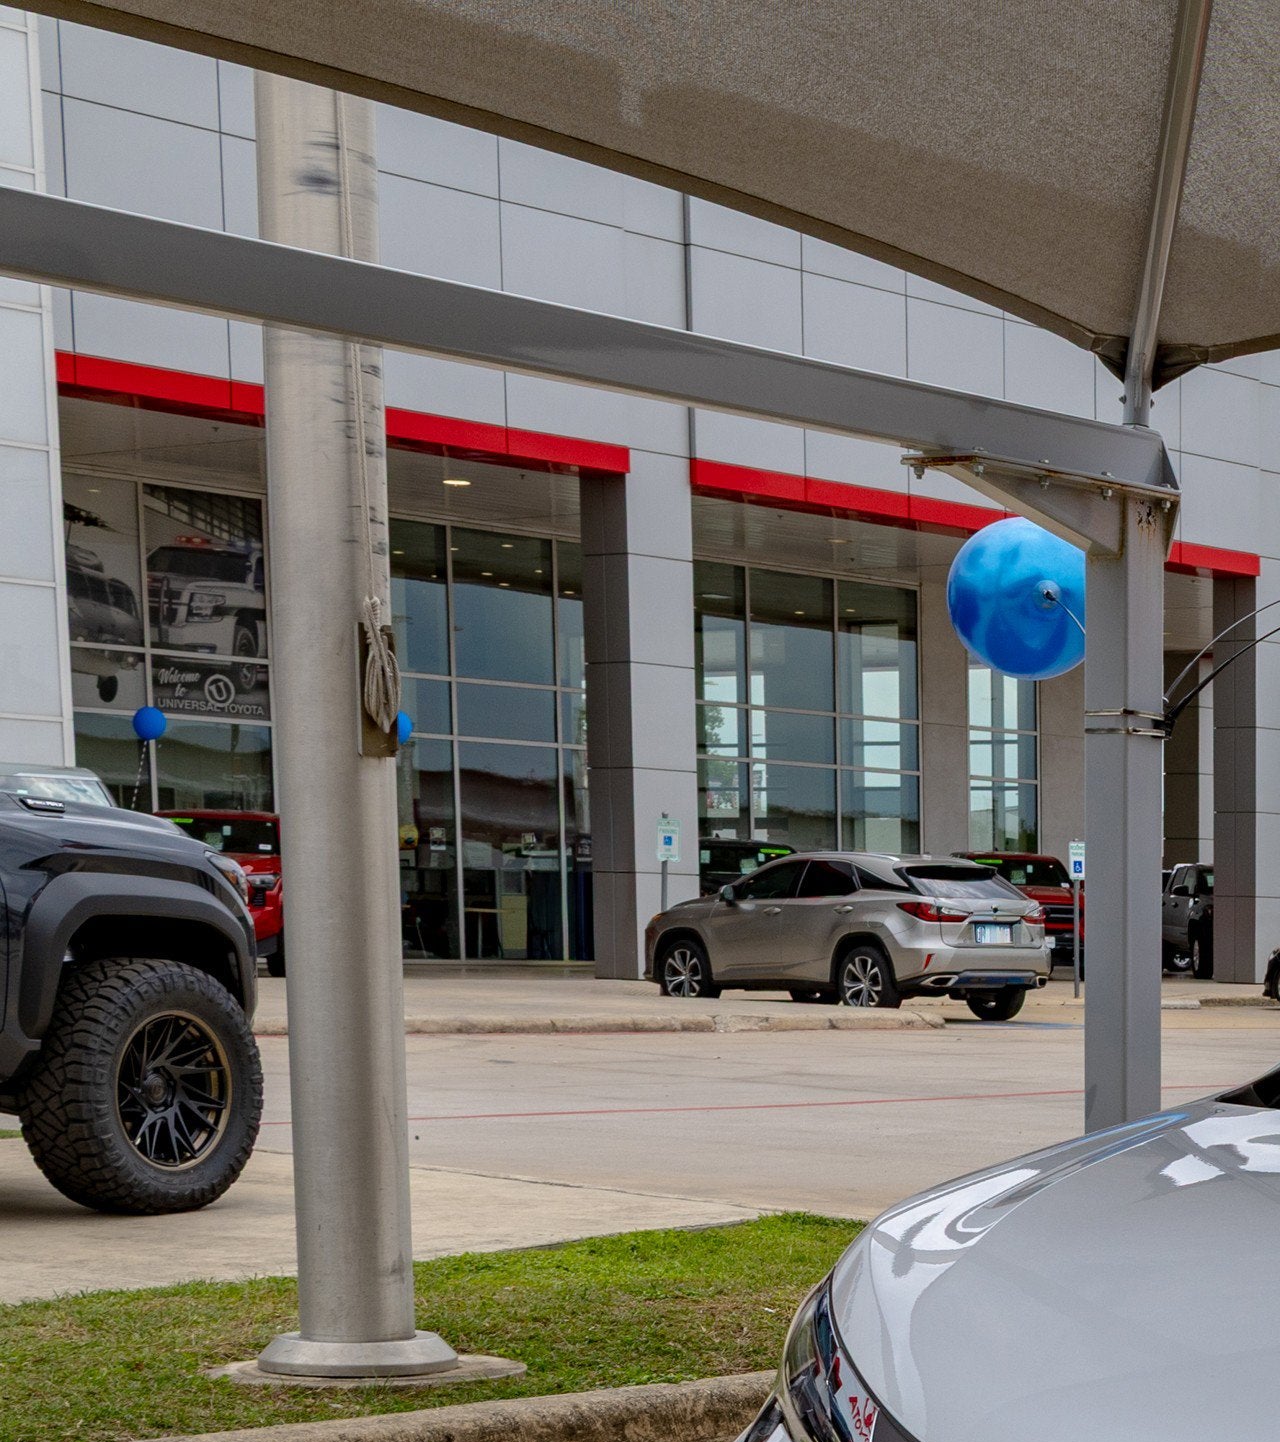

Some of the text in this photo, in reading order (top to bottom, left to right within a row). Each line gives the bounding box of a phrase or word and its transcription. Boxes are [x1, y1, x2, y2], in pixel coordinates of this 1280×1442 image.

[158, 666, 200, 685] Welcome
[158, 698, 265, 716] UNIVERSAL TOYOTA
